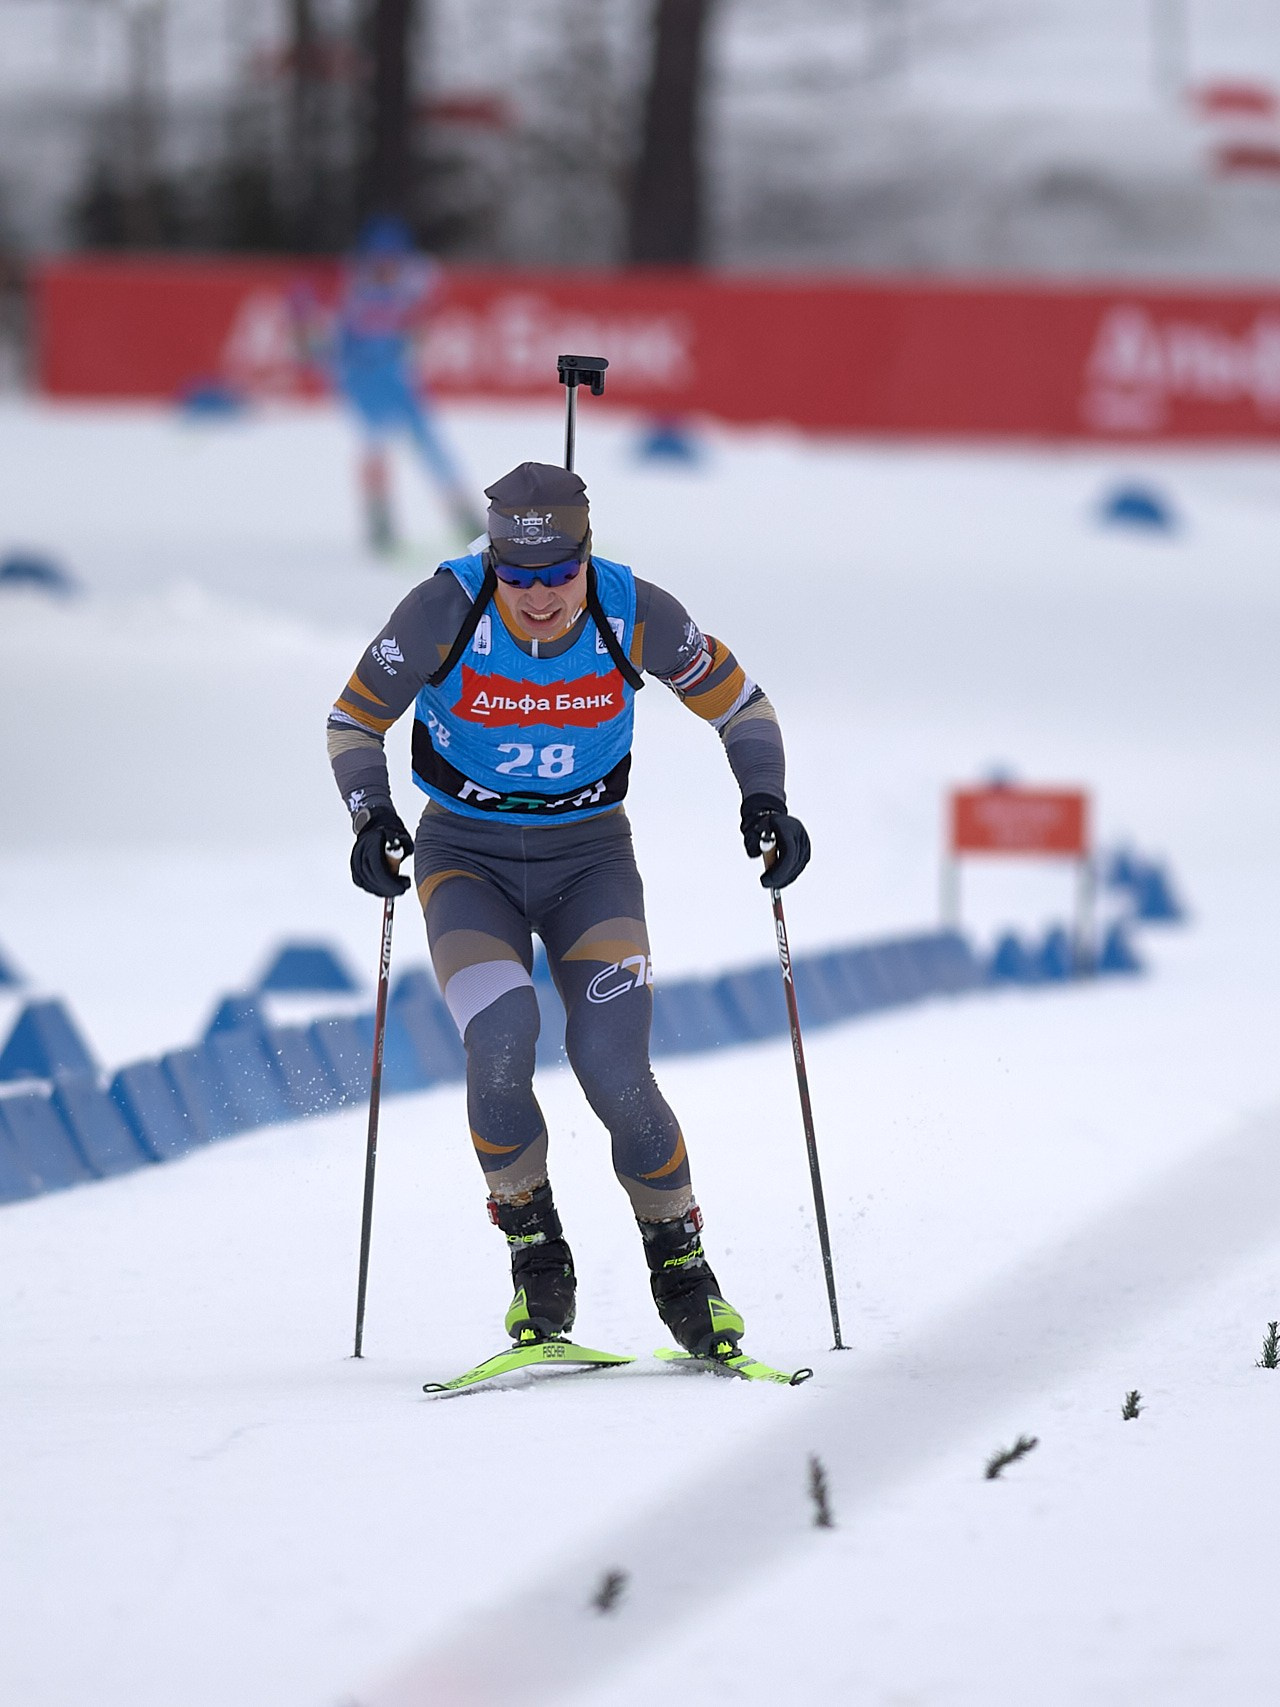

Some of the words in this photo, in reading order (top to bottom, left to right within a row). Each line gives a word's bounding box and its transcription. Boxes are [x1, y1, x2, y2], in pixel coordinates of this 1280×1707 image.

[471, 691, 550, 715] Альфа
[556, 692, 614, 710] Банк
[495, 743, 576, 779] 28
[542, 1345, 567, 1359] FISCHER
